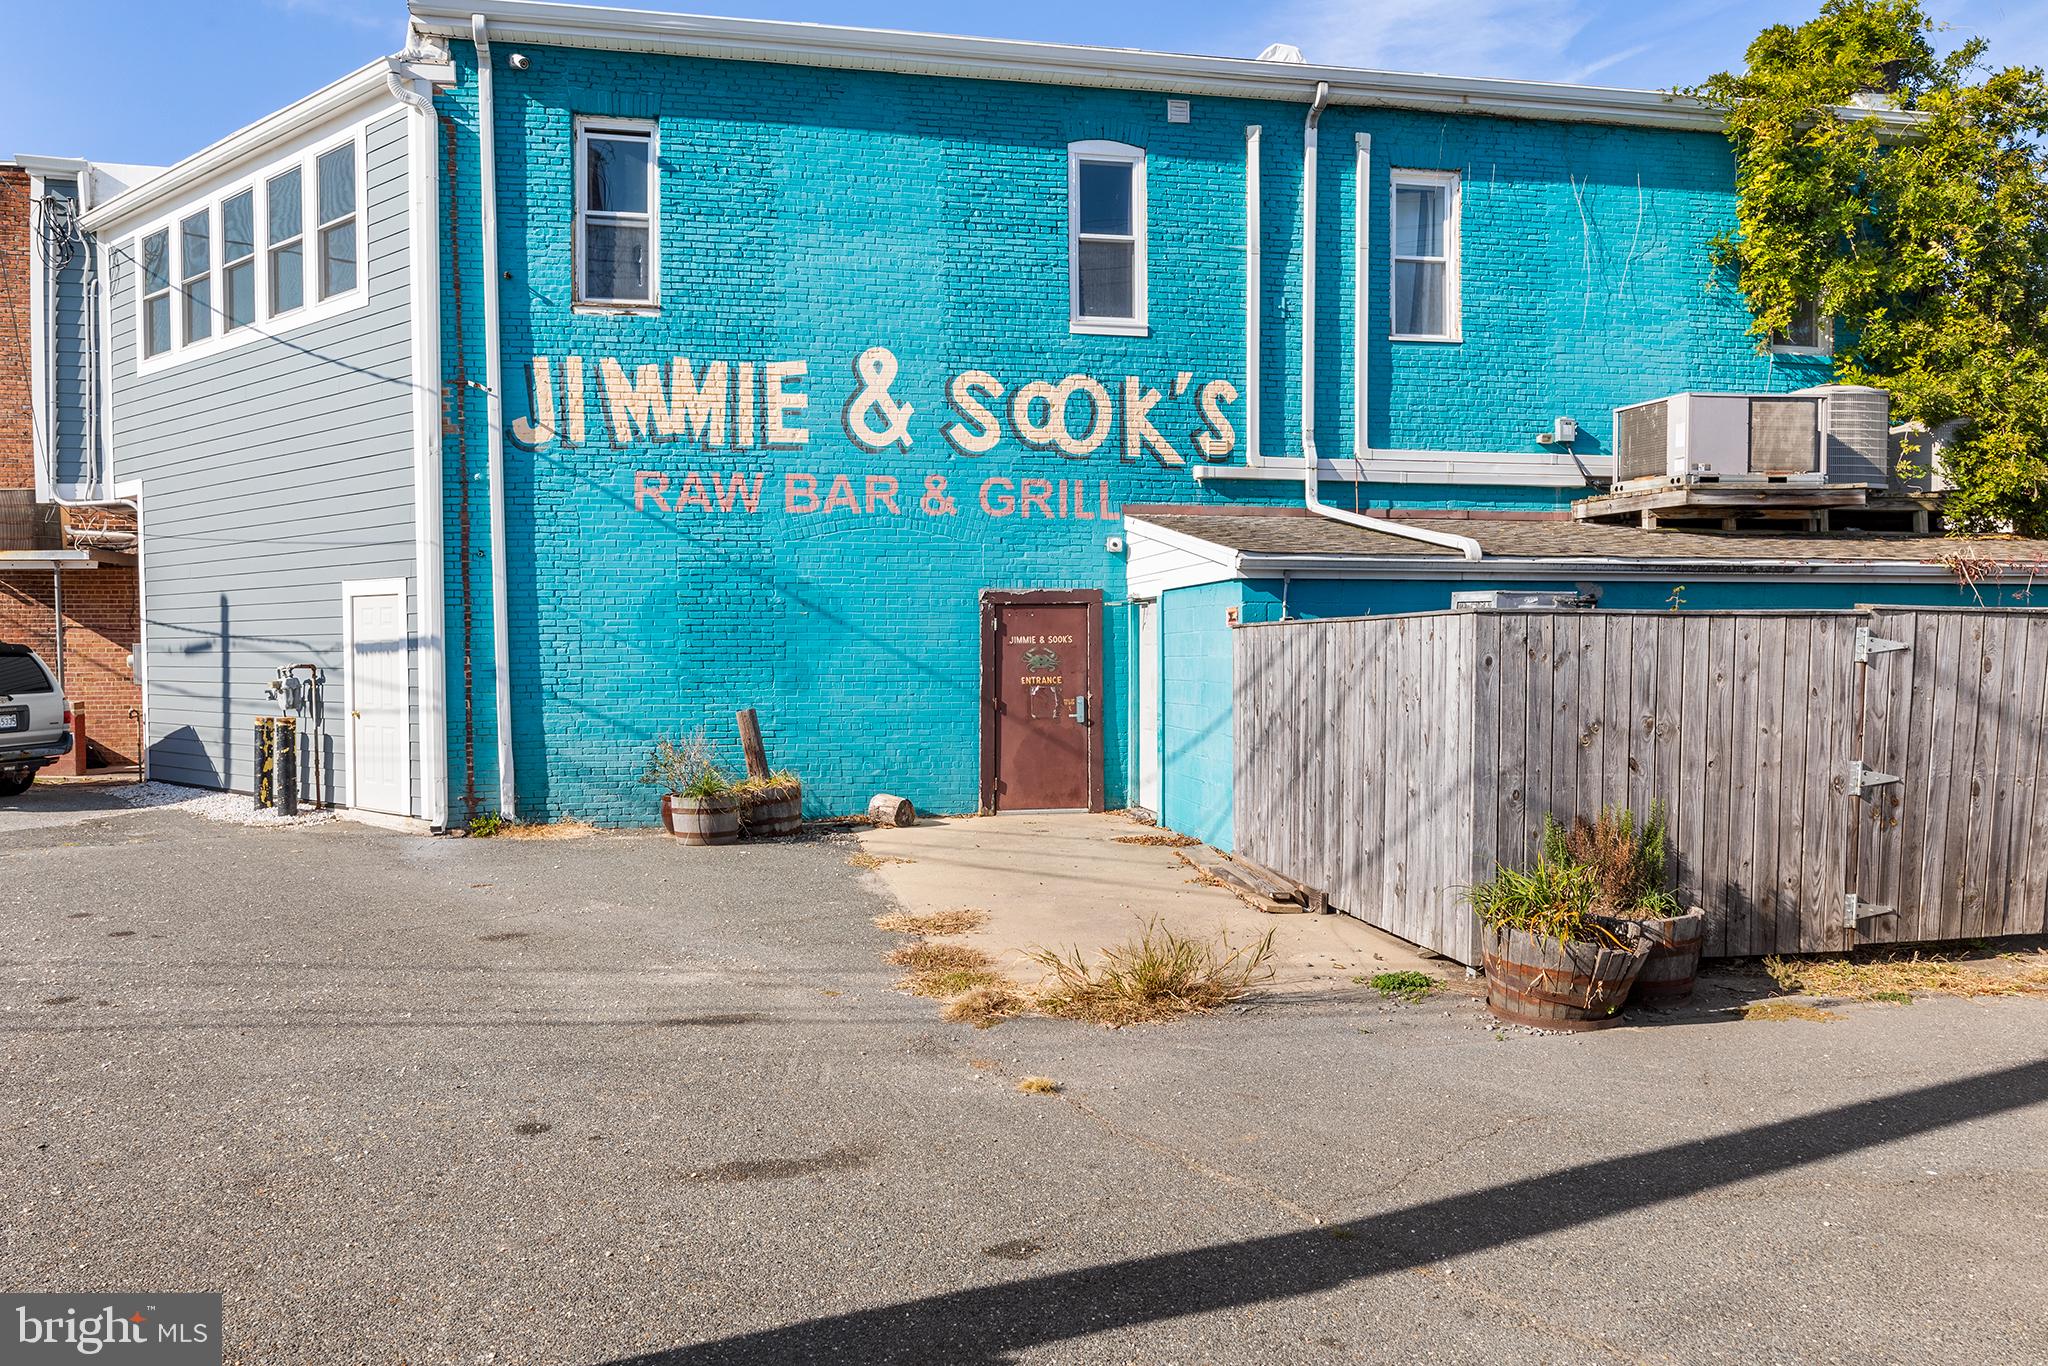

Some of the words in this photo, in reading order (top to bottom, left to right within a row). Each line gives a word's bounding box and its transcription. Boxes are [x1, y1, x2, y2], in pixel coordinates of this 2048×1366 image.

[508, 356, 809, 448] JIMMIE
[845, 347, 914, 450] &
[944, 370, 1239, 464] SOOK'S
[633, 470, 765, 514] RAW
[784, 473, 901, 515] BAR
[920, 474, 957, 517] &
[979, 477, 1121, 521] GRILL
[1009, 635, 1036, 644] JIMMIE
[1039, 635, 1045, 644] &
[1021, 676, 1062, 684] ENTRANCE
